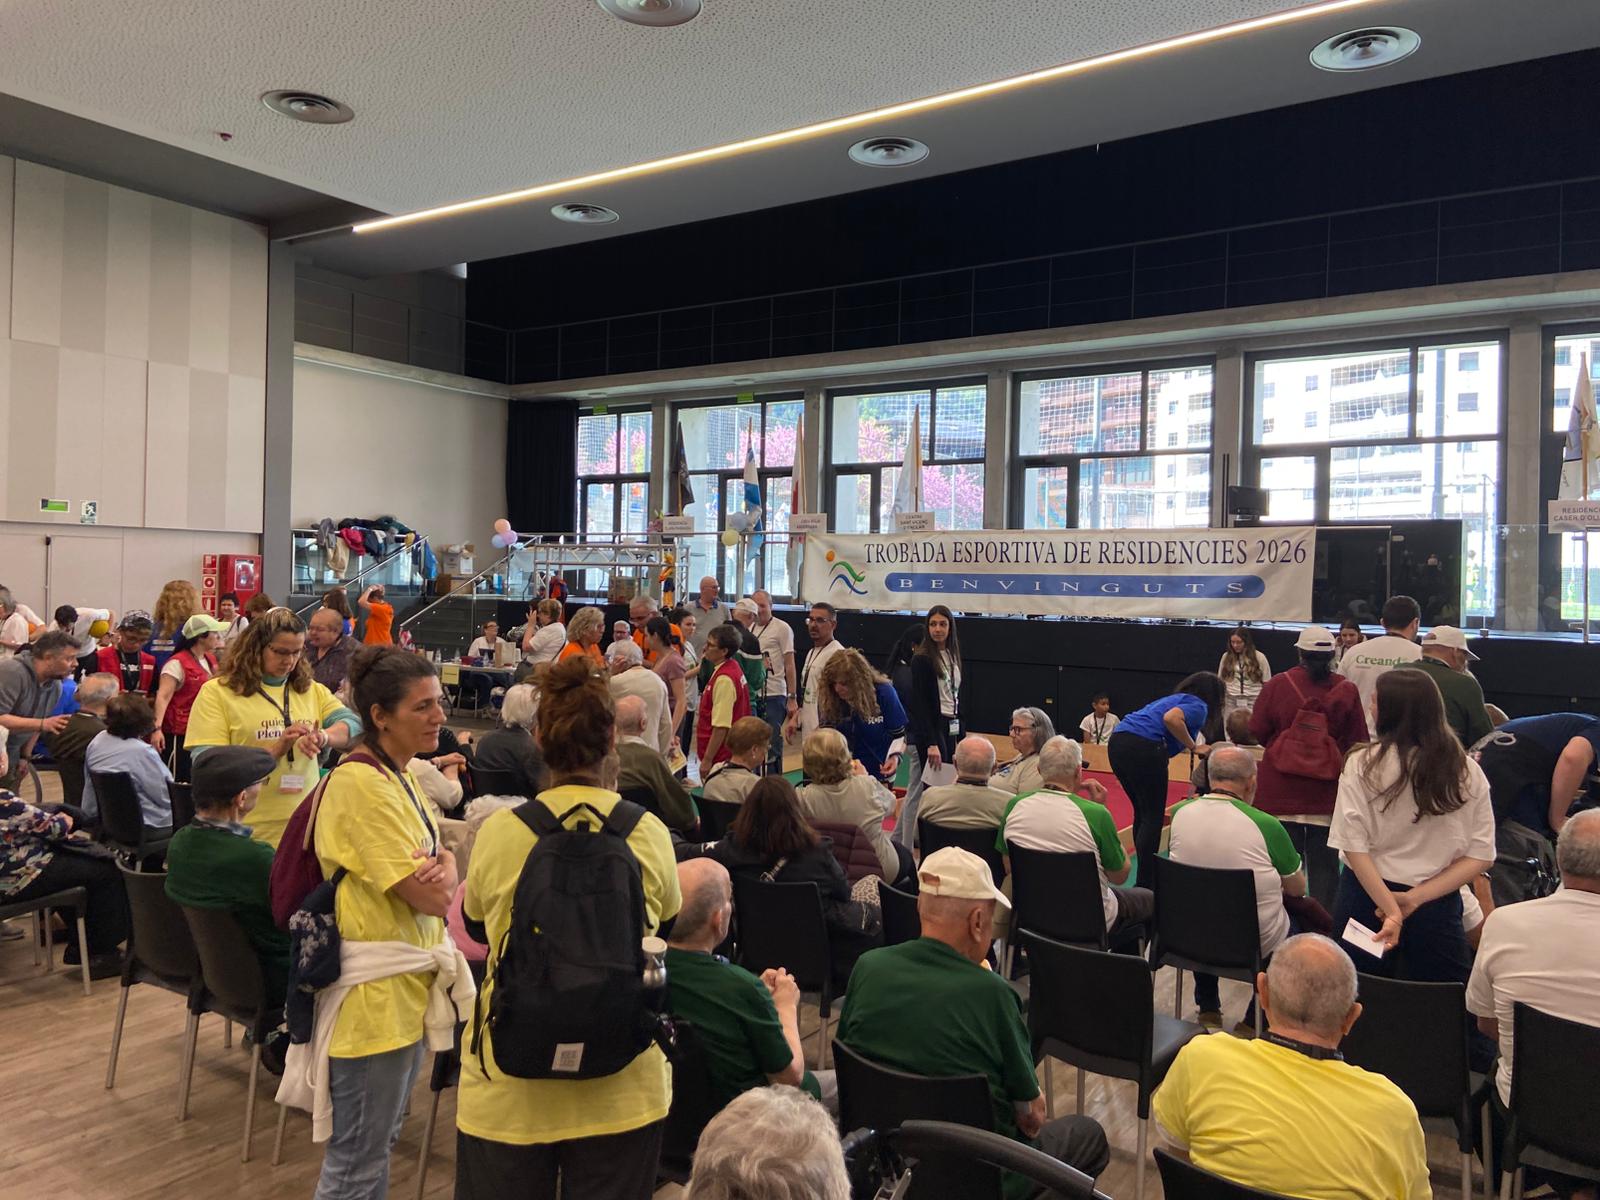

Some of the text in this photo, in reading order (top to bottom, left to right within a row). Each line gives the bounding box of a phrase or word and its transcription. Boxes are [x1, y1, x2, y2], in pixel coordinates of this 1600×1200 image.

[864, 539, 1307, 565] TROBADA ESPORTIVA DE RESIDENCIES 2026
[899, 578, 1244, 594] BENVINGUTS
